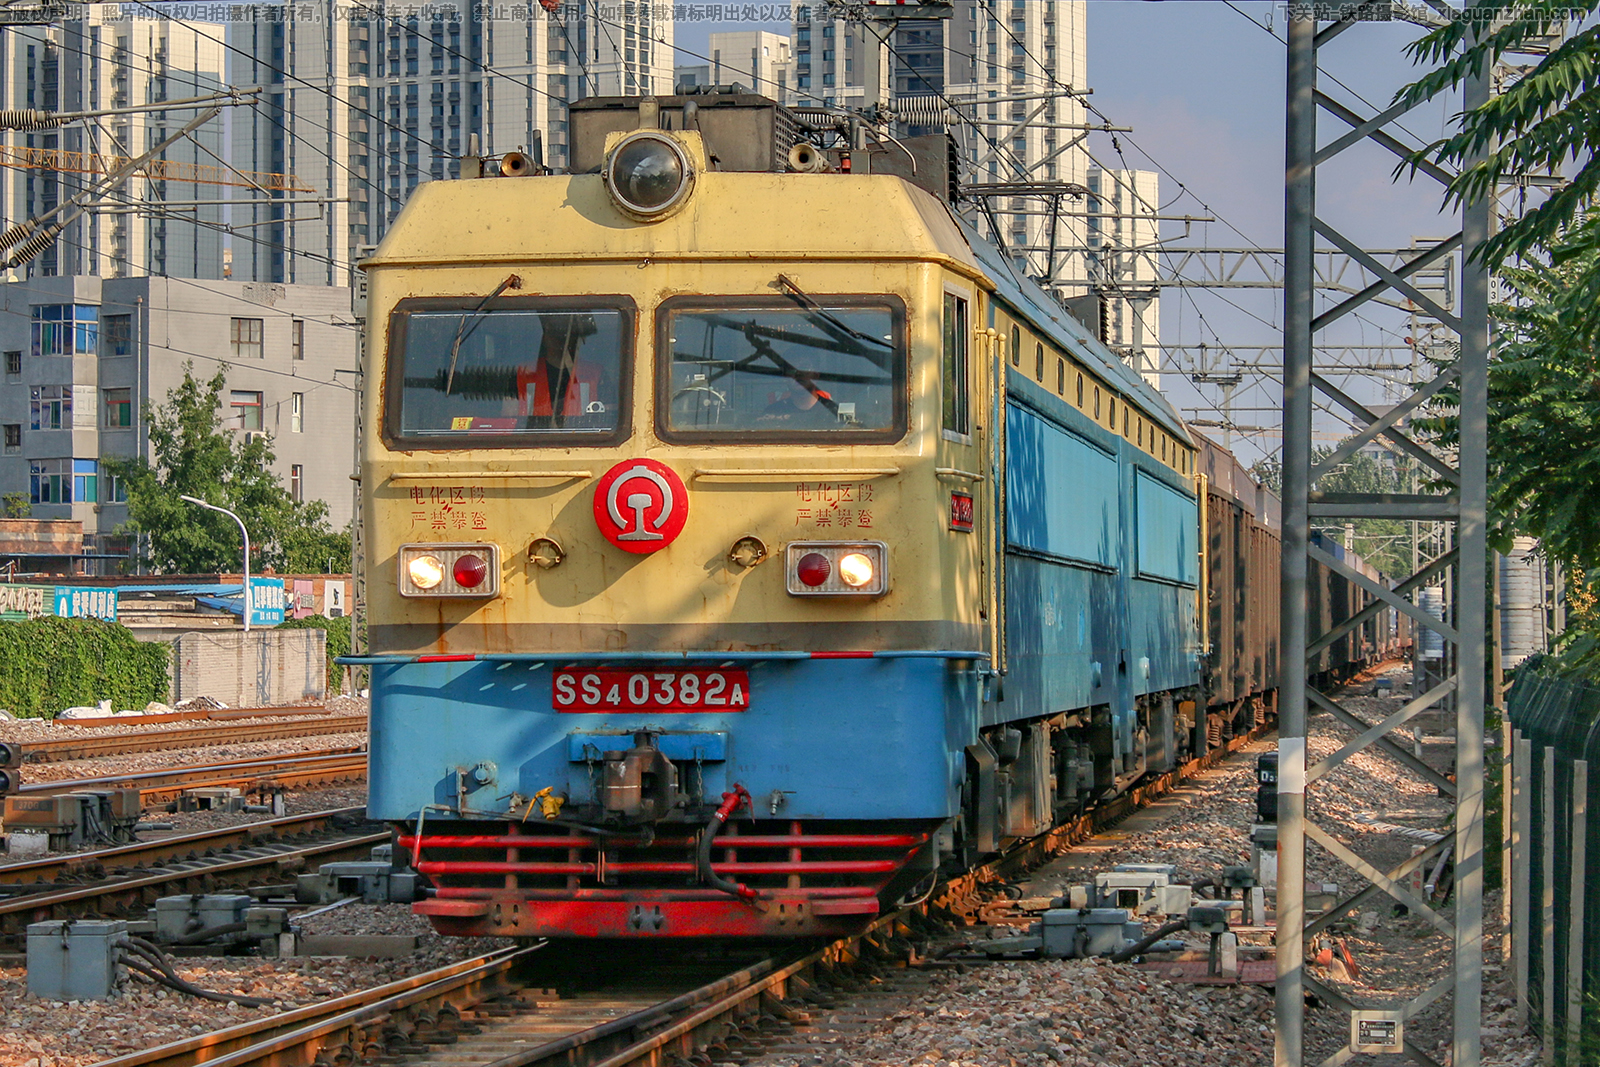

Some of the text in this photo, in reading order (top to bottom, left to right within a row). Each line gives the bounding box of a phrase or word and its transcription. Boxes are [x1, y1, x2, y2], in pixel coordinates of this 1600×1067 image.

[409, 485, 486, 505] 电化区段
[795, 482, 874, 503] 电化区段
[410, 509, 488, 530] 严禁攀登
[795, 508, 874, 529] 严禁攀登
